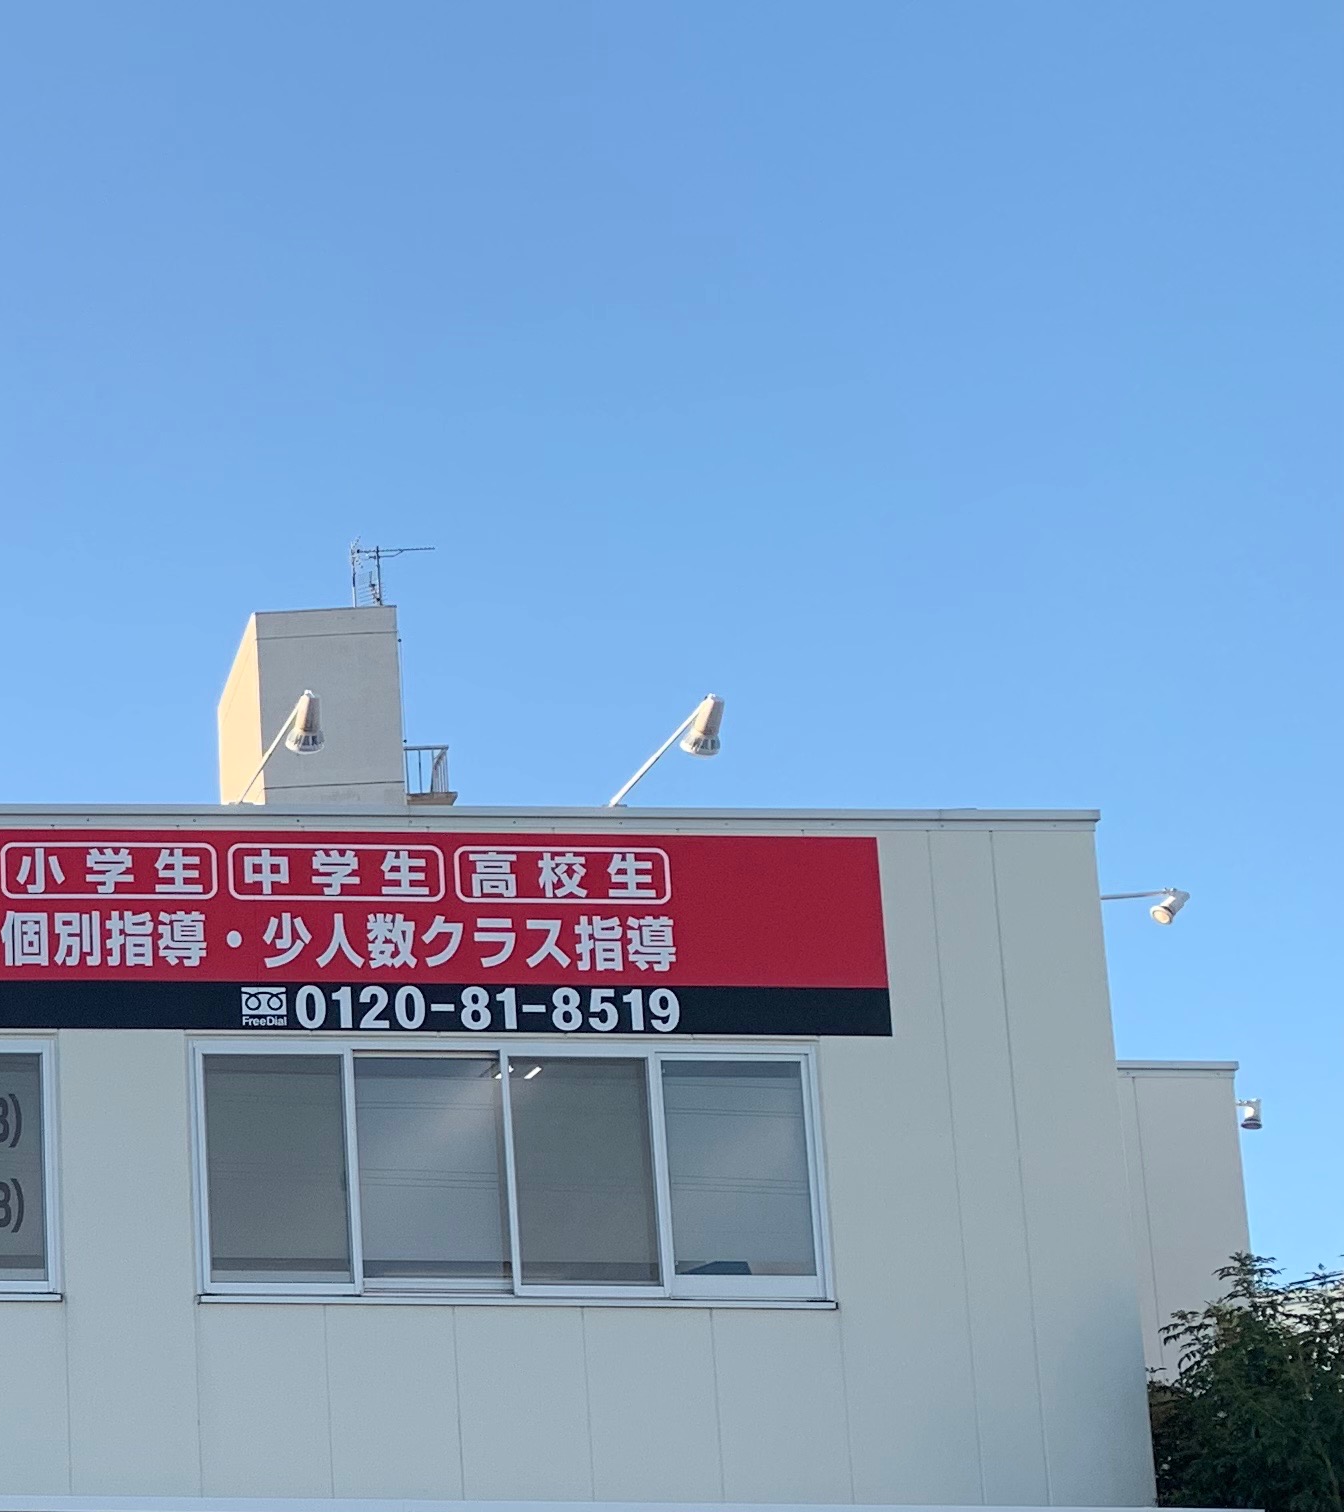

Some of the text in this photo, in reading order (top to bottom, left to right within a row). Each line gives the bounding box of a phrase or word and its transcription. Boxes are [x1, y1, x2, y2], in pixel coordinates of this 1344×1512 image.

[16, 847, 204, 895] 小学生
[242, 849, 431, 897] 中学生
[469, 850, 658, 899] 高校生
[0, 909, 677, 973] 個別指導・少人数クラス指導
[296, 985, 680, 1033] 0120-81-8519
